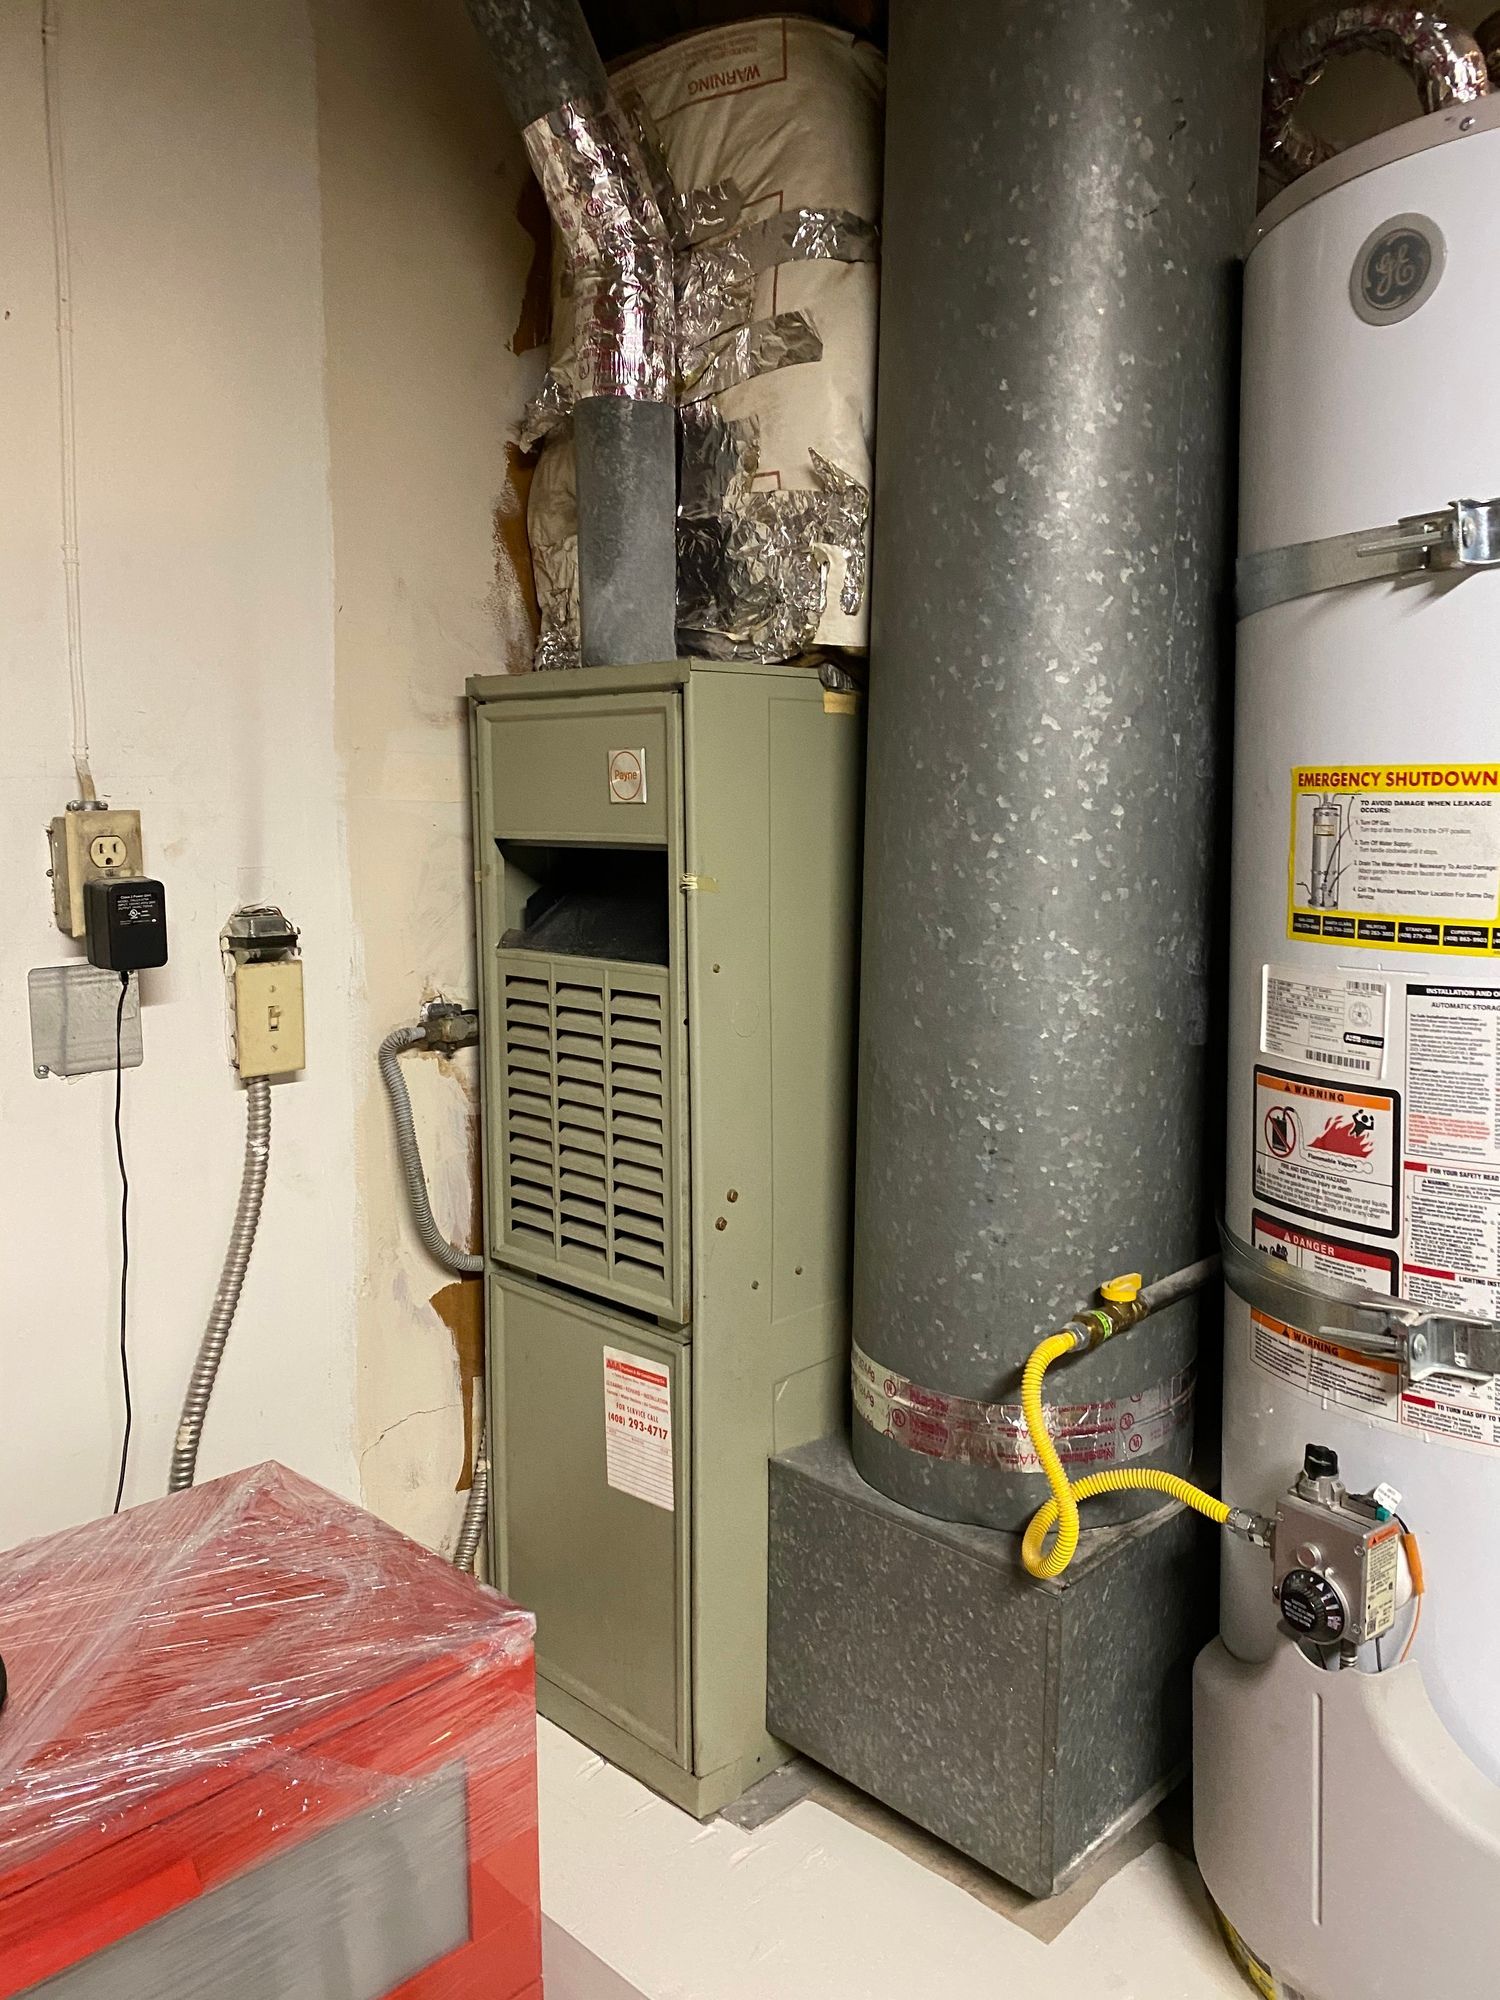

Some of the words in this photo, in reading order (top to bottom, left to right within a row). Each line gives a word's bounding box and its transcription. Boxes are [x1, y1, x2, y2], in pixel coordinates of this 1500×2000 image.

[688, 64, 760, 95] WARNING
[615, 770, 637, 781] Payne
[1298, 772, 1381, 787] EMERGENCY
[1386, 771, 1498, 786] SHUTDOWN
[1426, 988, 1474, 996] INSTALLATION
[1295, 1085, 1344, 1102] WARNING
[1308, 1153, 1336, 1164] Flammable
[1338, 1160, 1357, 1168] Vapors
[1460, 1172, 1481, 1180] SAFETY
[1293, 1235, 1335, 1256] DANGER
[1459, 1276, 1485, 1285] LIGHTING
[1487, 1279, 1500, 1287] INST
[1294, 1332, 1339, 1356] WARNING
[616, 1402, 625, 1411] FOR
[627, 1406, 645, 1418] SERVICE
[647, 1414, 658, 1423] CALL
[608, 1412, 625, 1426] (408)
[629, 1417, 668, 1440] 293-4717
